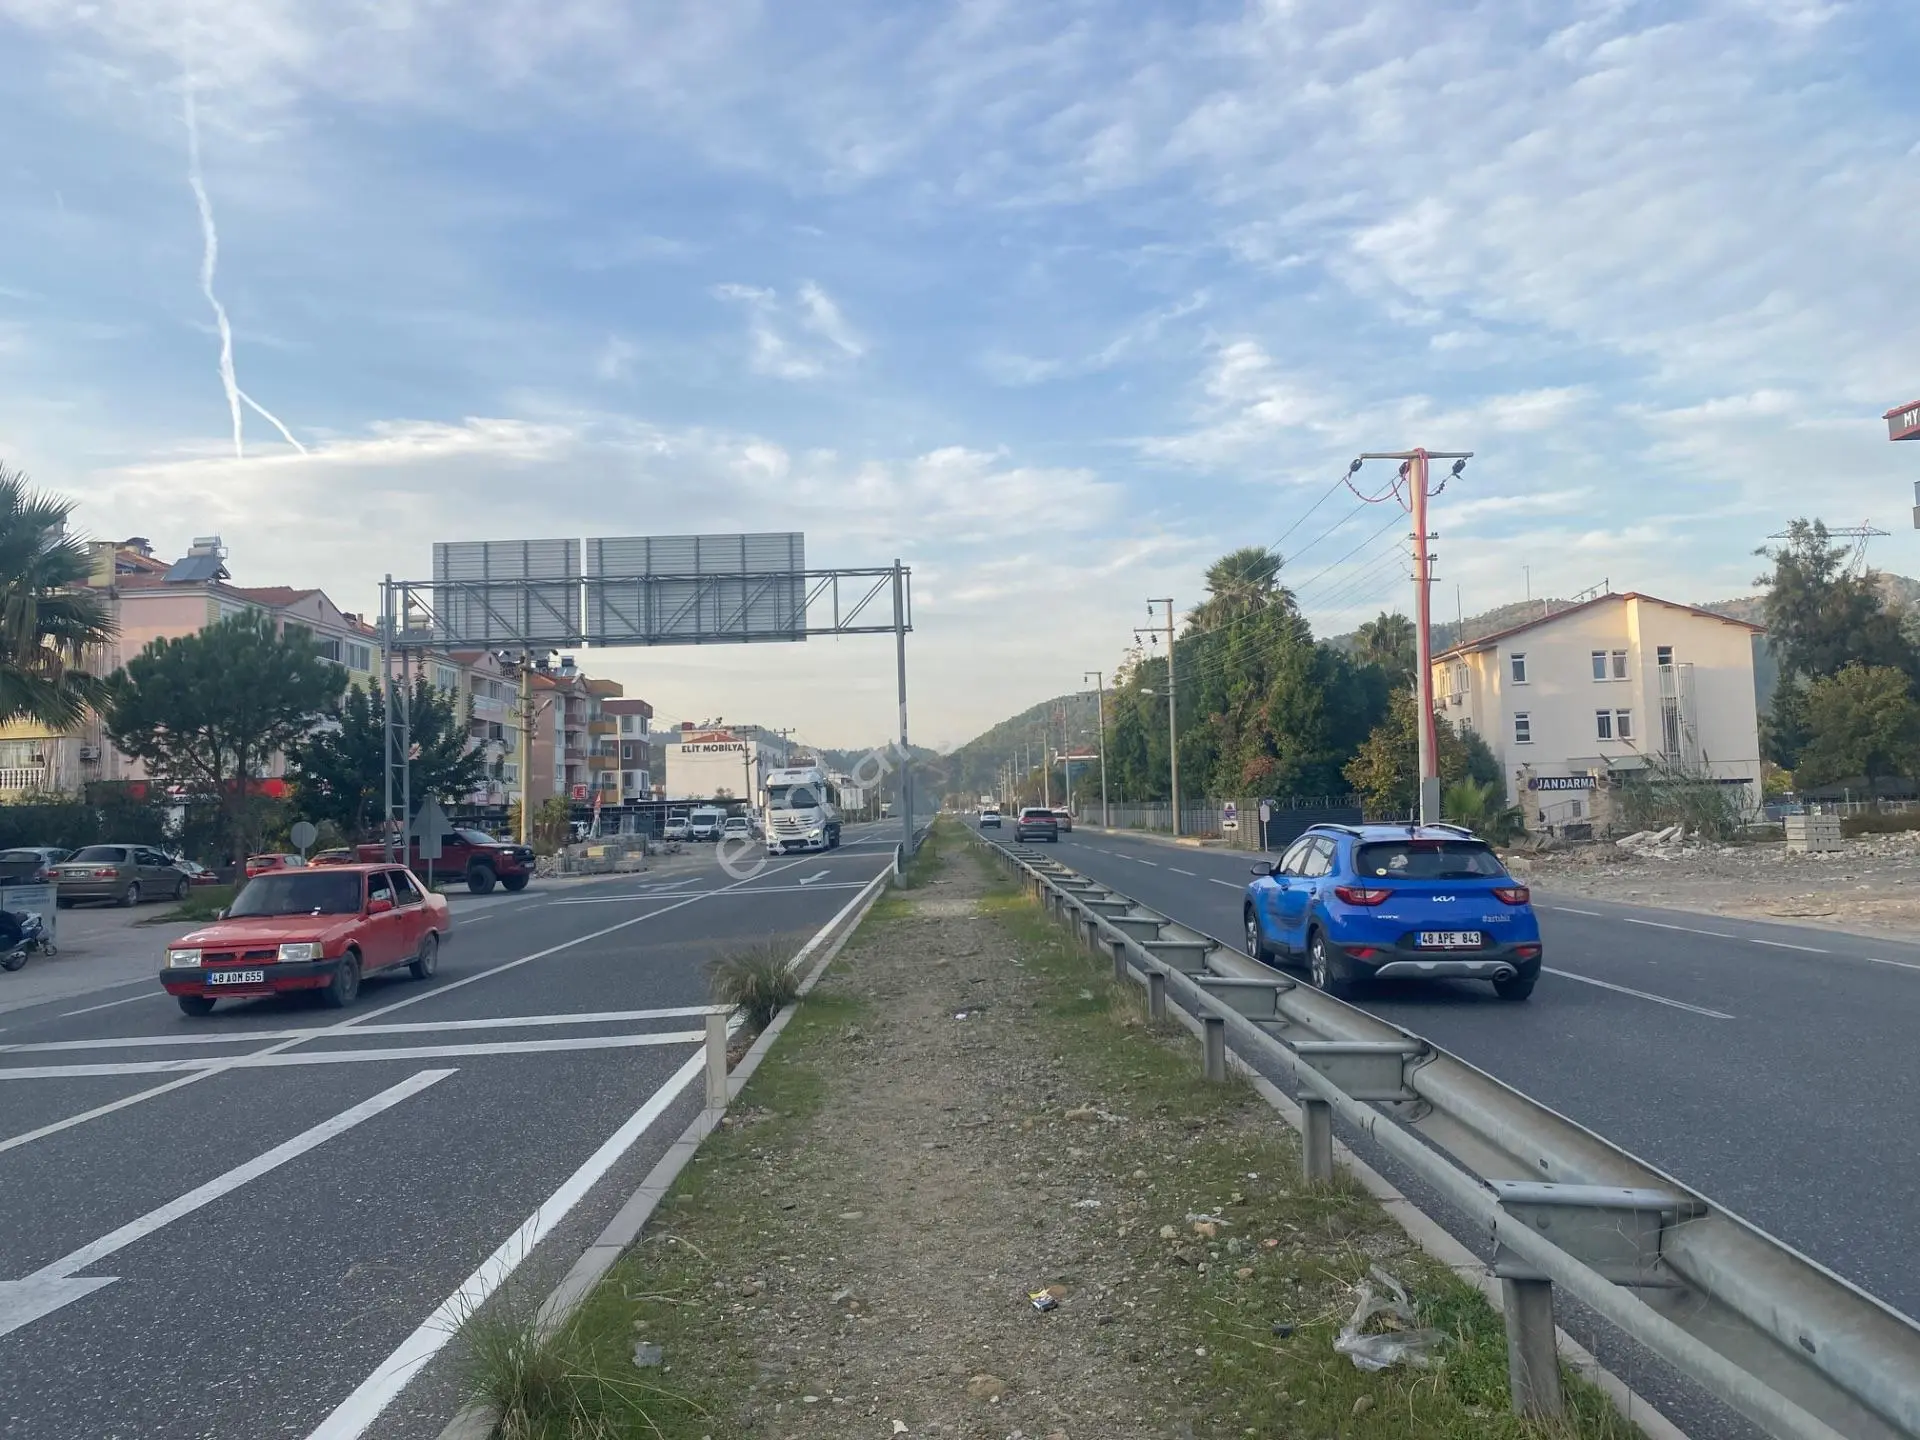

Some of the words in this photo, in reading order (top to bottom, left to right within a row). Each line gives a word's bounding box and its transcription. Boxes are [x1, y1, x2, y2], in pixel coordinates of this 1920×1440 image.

[1904, 408, 1919, 428] MY
[1538, 778, 1596, 790] JANDARMA
[1422, 933, 1434, 944] 48
[1438, 933, 1456, 944] APE
[1462, 933, 1480, 944] 843
[212, 973, 224, 983] 48
[245, 971, 262, 982] 655
